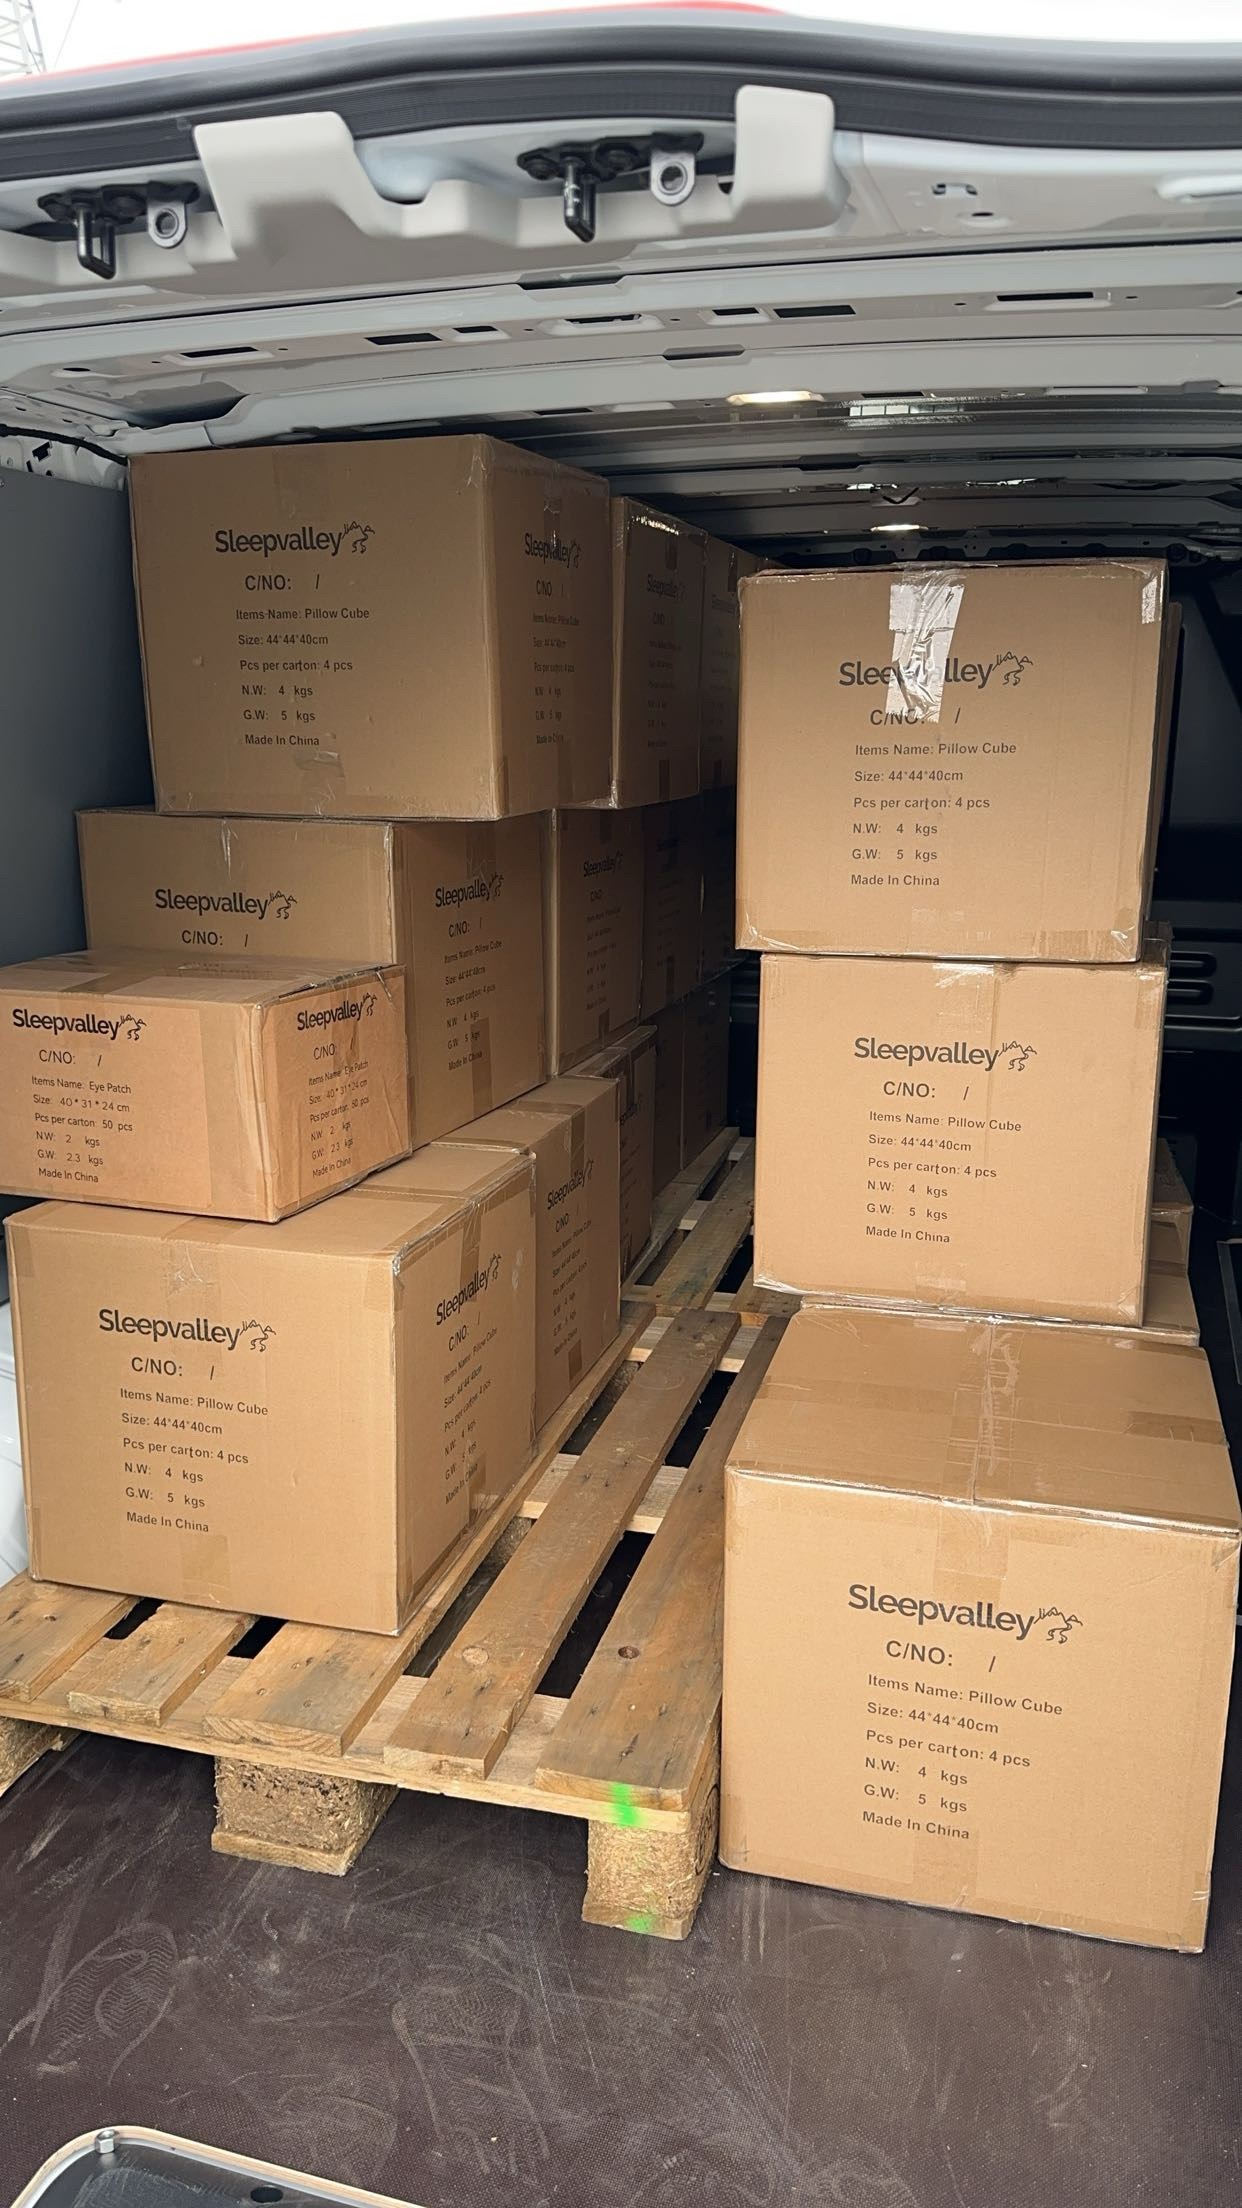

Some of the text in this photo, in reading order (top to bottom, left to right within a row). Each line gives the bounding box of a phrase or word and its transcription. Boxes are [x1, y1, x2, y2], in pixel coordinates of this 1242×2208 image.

[215, 526, 343, 557] Sleepvalley
[245, 574, 320, 591] C/NO: /
[304, 608, 338, 620] Pillow
[340, 608, 370, 619] Cube
[238, 635, 263, 645] Size:
[239, 660, 353, 673] Pcs per carton: 4 pcs
[278, 685, 285, 696] 4
[294, 685, 313, 698] kgs
[281, 710, 287, 721] 5
[296, 710, 316, 723] kgs
[954, 708, 961, 724] /
[245, 735, 320, 746] Made In China
[855, 742, 1017, 756] Items Name: Pillow Cube
[854, 771, 883, 782] Size:
[853, 797, 990, 811] Pcs per carton: 4 pcs
[852, 823, 938, 837] N.W: 4 kgs
[852, 849, 938, 862] G.W: 5 kgs
[851, 875, 940, 886] Made In China
[435, 879, 491, 908] Sleepvalley
[154, 888, 269, 920] Sleepvalley
[181, 929, 249, 947] C/NO: /
[12, 1008, 121, 1041] Sleepvalley
[297, 1001, 363, 1031] Sleepvalley
[38, 1049, 75, 1065] C/NO:
[854, 1037, 1000, 1072] Sleepvalley
[31, 1075, 56, 1087] Items
[89, 1081, 105, 1093] Eye
[107, 1082, 132, 1094] Patch
[883, 1081, 970, 1101] C/NO: /
[59, 1097, 73, 1107] 40
[81, 1100, 92, 1109] 31
[102, 1101, 115, 1111] 24
[116, 1104, 130, 1113] cm
[34, 1113, 49, 1123] Pcs
[51, 1116, 65, 1125] per
[102, 1120, 114, 1130] 50
[117, 1123, 133, 1133] pcs
[869, 1111, 1022, 1132] Items Name: Pillow Cube
[65, 1134, 72, 1144] 2
[84, 1135, 100, 1149] kgs
[868, 1134, 896, 1146] Size:
[88, 1154, 104, 1167] kgs
[868, 1157, 997, 1179] Pcs per carton: 4 pcs
[38, 1167, 99, 1183] Made In China
[867, 1180, 948, 1199] N.W: 4 kgs
[866, 1203, 948, 1222] G.W: 5 kgs
[866, 1226, 950, 1243] Made In China
[435, 1265, 490, 1326] Sleepvalley
[99, 1308, 241, 1351] Sleepvalley
[131, 1357, 215, 1381] C/NO: /
[120, 1388, 269, 1416] Items Name: Pillow Cube
[121, 1412, 149, 1426] Size:
[123, 1437, 249, 1464] Pcs per carton: 4 pcs
[124, 1462, 204, 1484] N.W: 4 kgs
[125, 1487, 206, 1509] G.W: 5 kgs
[126, 1511, 209, 1533] Made In China
[848, 1583, 1035, 1641] Sleepvalley
[886, 1640, 996, 1673] C/NO: /
[868, 1674, 1063, 1715] Items Name: Pillow Cube
[867, 1701, 903, 1718] Size:
[866, 1729, 1031, 1767] Pcs per carton: 4 pcs
[865, 1757, 968, 1786] N.W: 4 kgs
[863, 1784, 968, 1813] G.W: 5 kgs
[862, 1811, 970, 1840] Made In China
